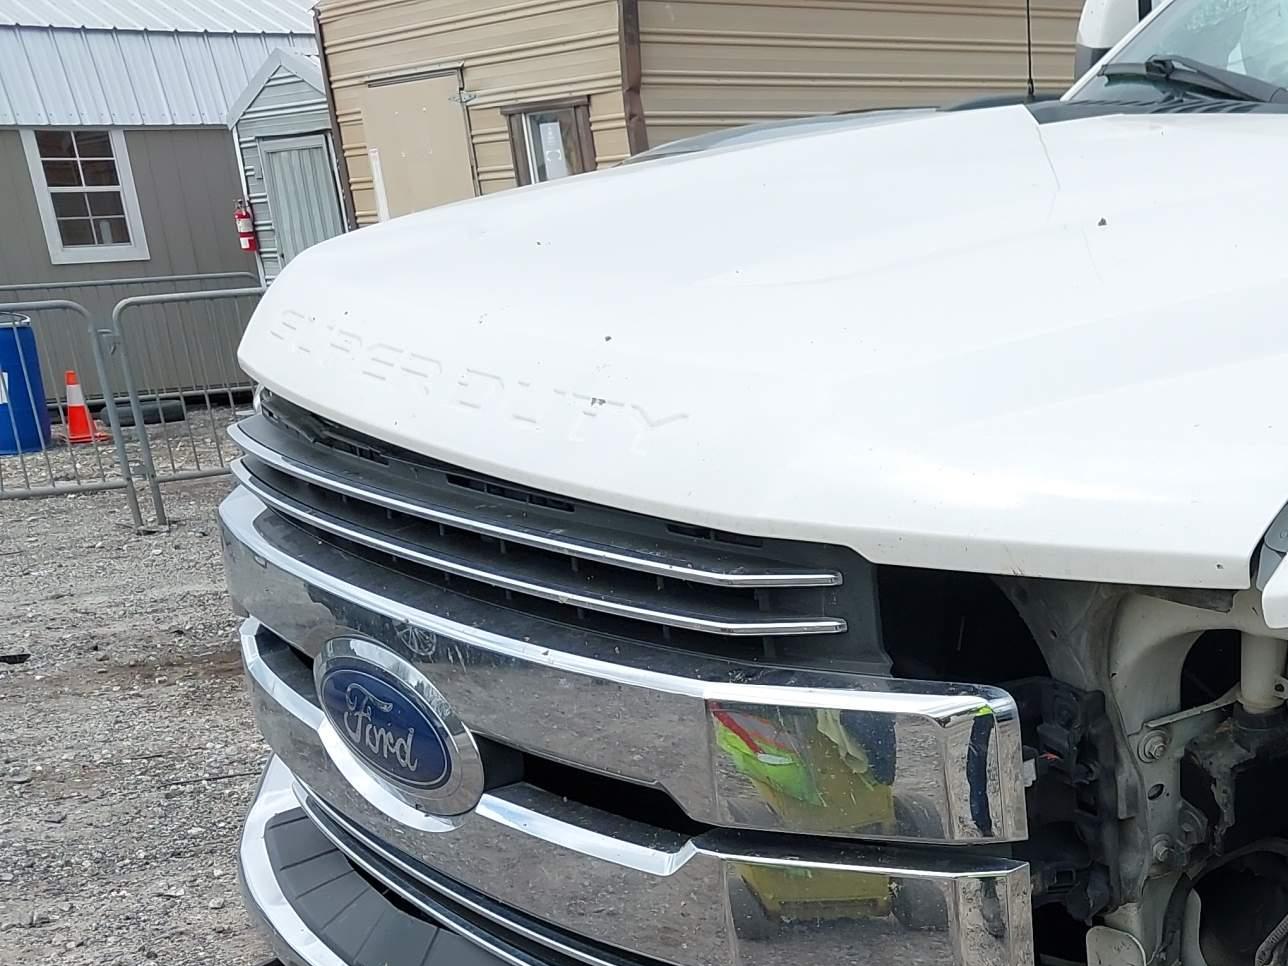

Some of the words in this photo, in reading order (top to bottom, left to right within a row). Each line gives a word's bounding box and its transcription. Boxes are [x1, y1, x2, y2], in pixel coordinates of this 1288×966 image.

[270, 309, 443, 397] SUPER
[457, 367, 690, 457] DUTY
[343, 682, 419, 772] Ford
